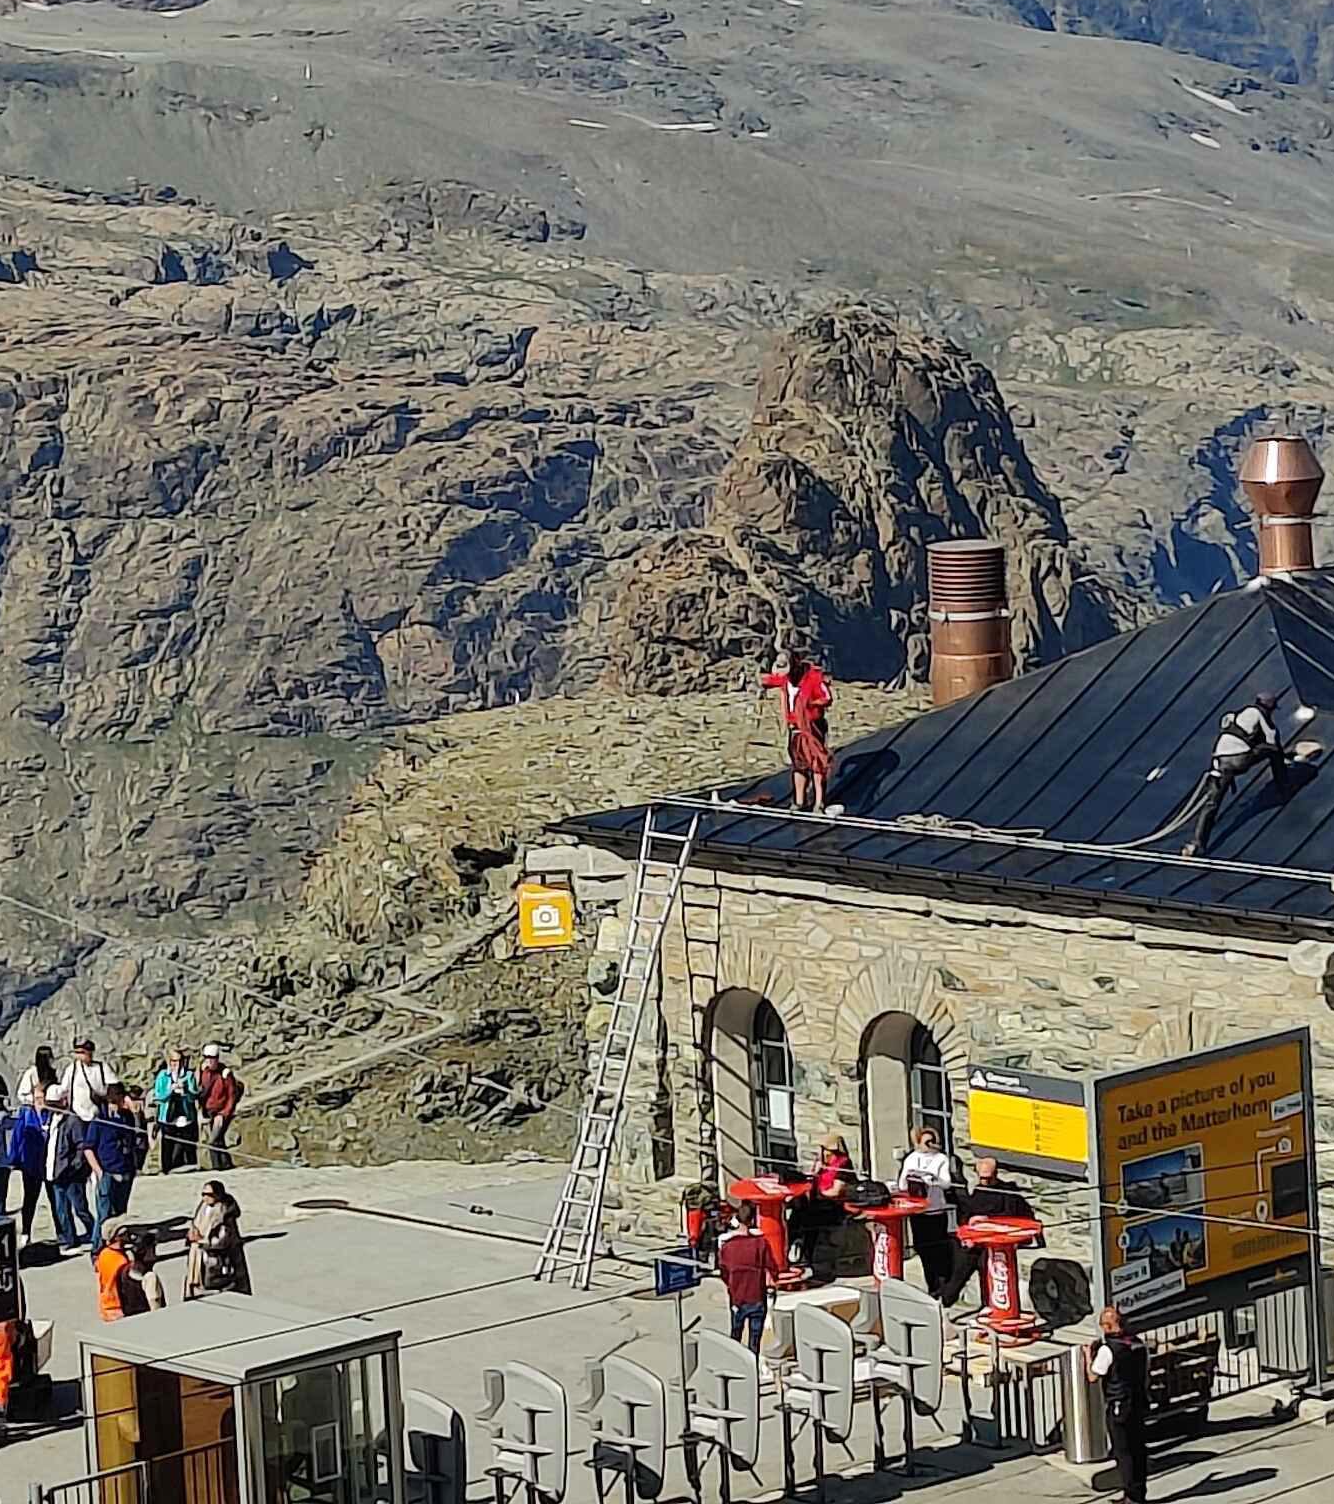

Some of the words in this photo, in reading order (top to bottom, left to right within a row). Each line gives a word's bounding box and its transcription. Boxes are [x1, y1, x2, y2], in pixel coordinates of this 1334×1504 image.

[1118, 1101, 1153, 1124] Take
[1157, 1099, 1167, 1114] a
[1170, 1082, 1226, 1115] picture
[1229, 1073, 1245, 1095] of
[1249, 1071, 1276, 1094] you
[1118, 1126, 1148, 1151] and
[1152, 1121, 1177, 1141] the
[1180, 1098, 1268, 1133] Matterhorn
